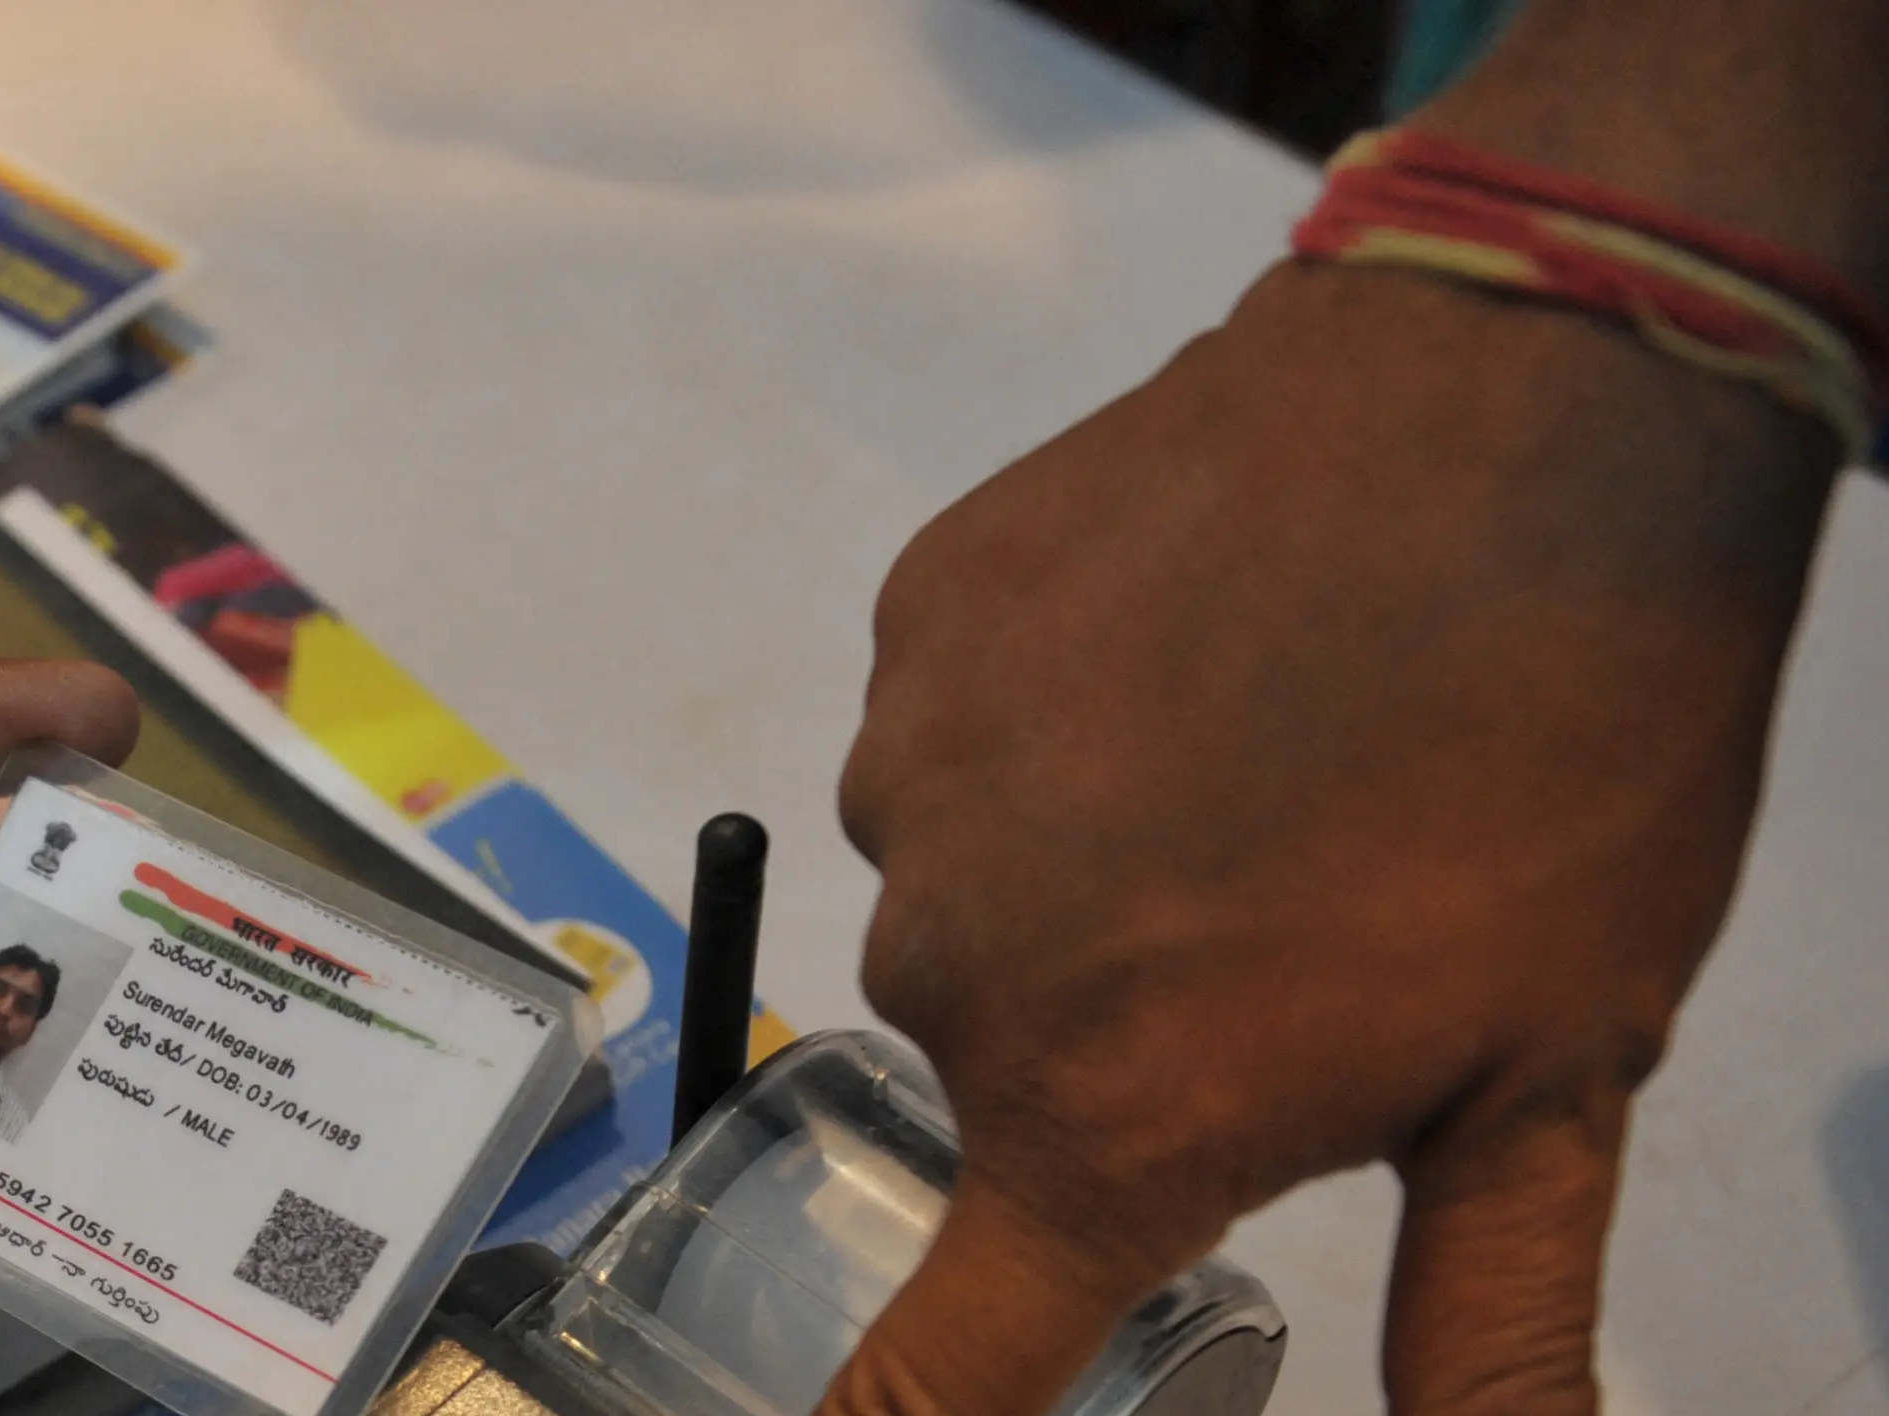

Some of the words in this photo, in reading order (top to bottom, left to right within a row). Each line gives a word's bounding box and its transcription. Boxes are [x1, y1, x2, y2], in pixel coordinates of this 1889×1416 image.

[181, 924, 303, 990] GOVERNMENT
[300, 980, 328, 1003] OF
[325, 992, 373, 1027] INDIA
[233, 917, 280, 952] भारत
[291, 945, 355, 988] सरकार
[123, 980, 206, 1033] Surendar
[205, 1021, 296, 1079] Megavath
[181, 1109, 235, 1147] MALE
[197, 1058, 243, 1094] DOB:
[246, 1084, 361, 1152] 03/04/1989
[57, 1204, 115, 1247] 7055
[122, 1241, 178, 1282] 1665
